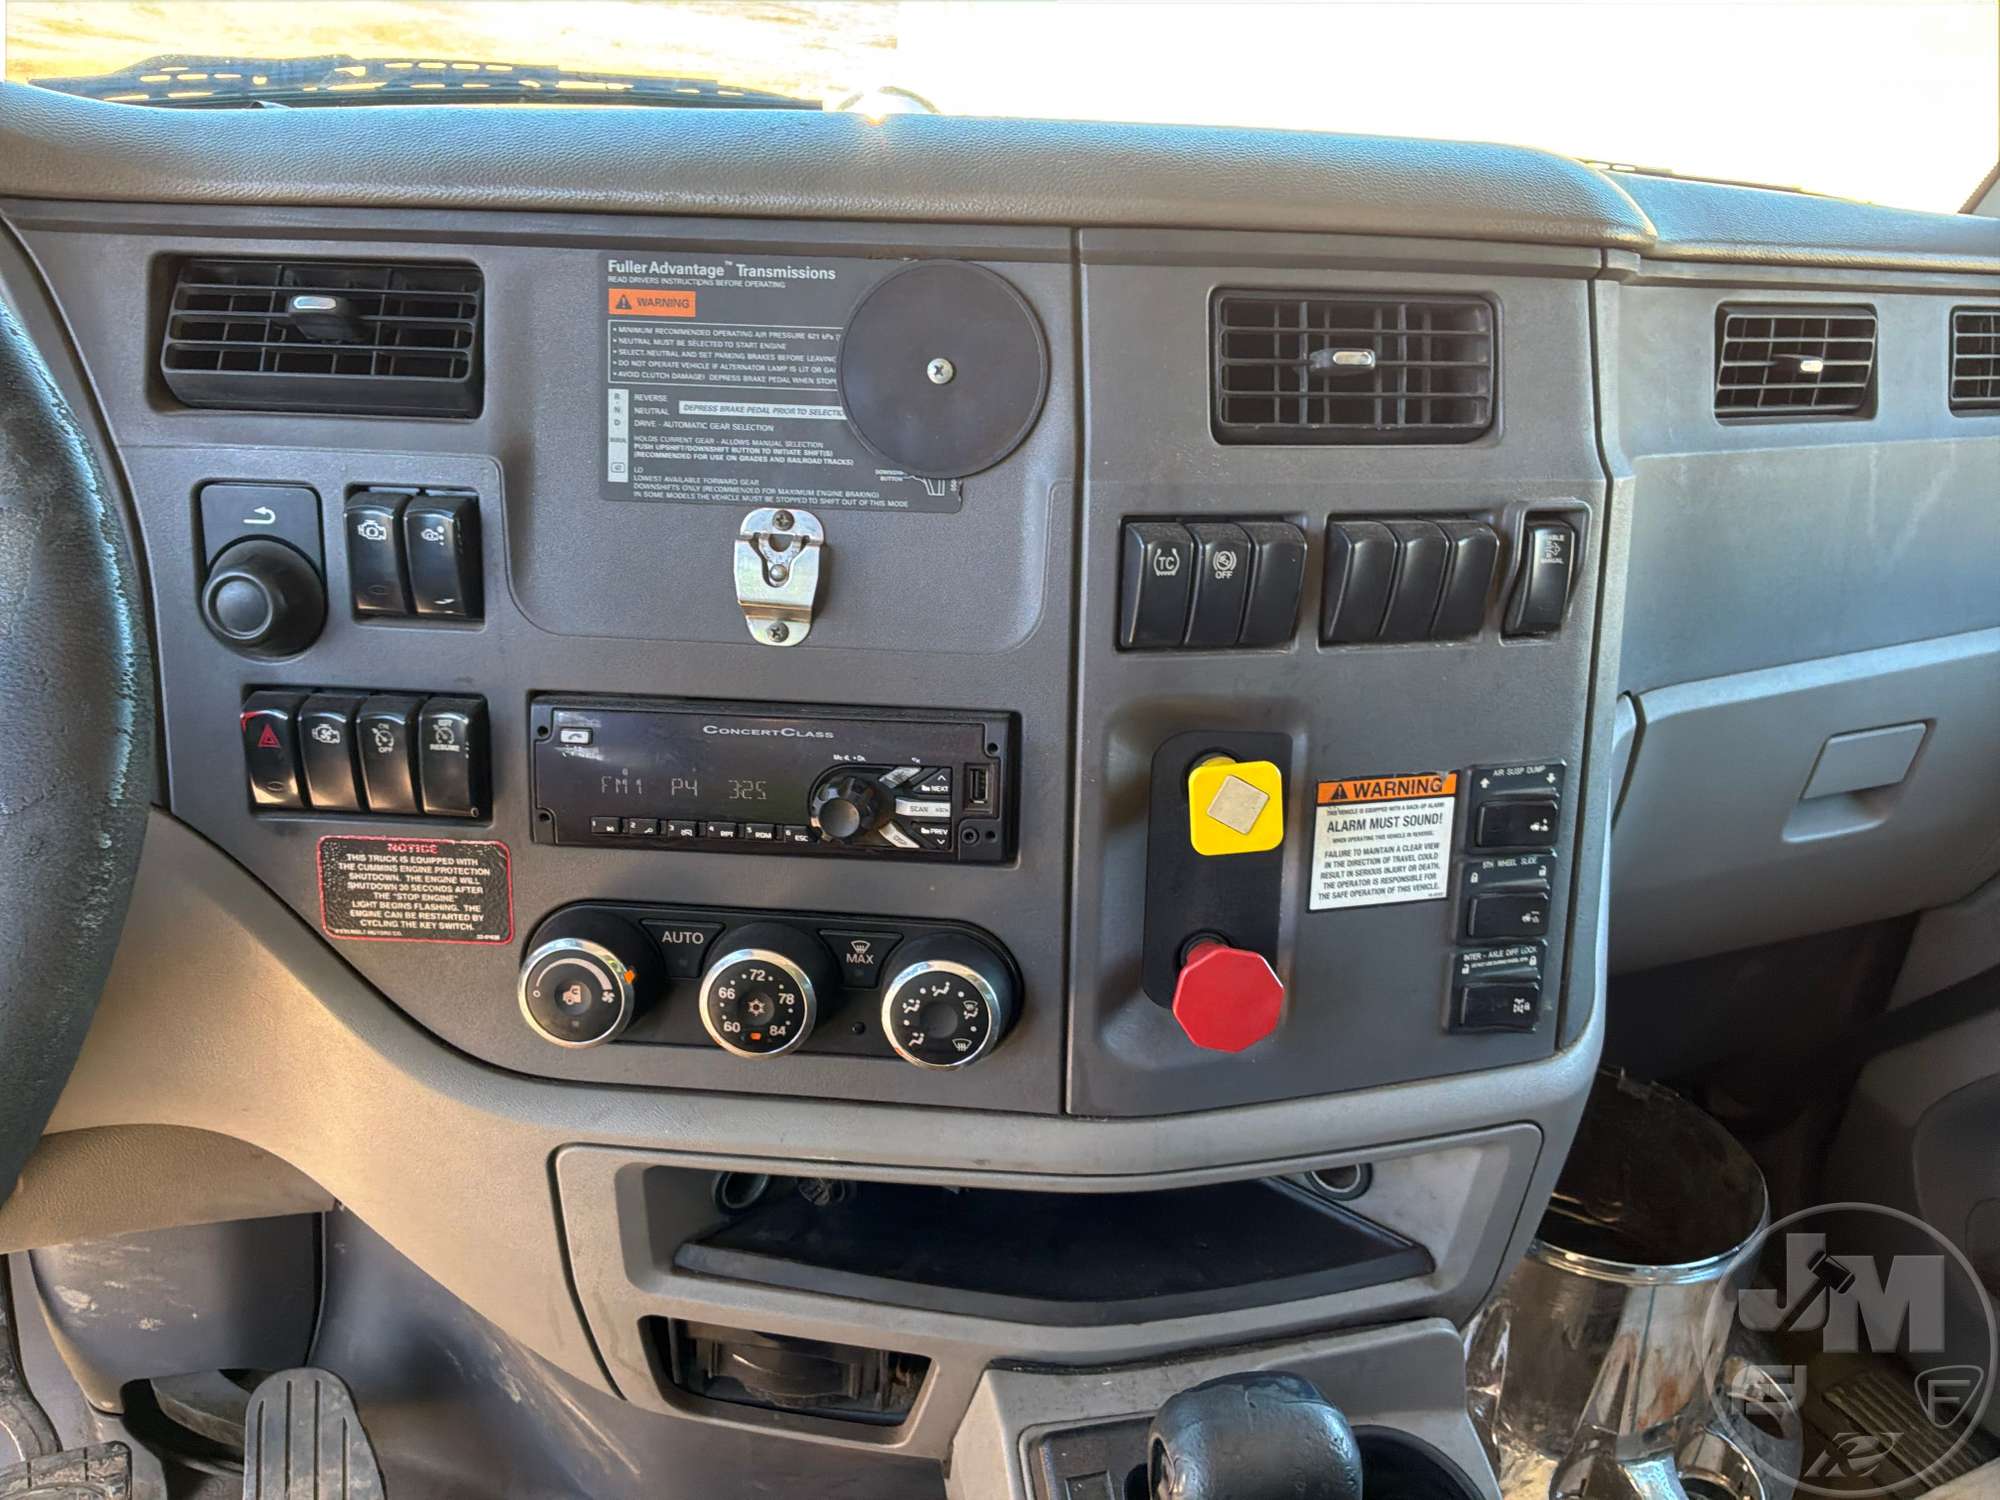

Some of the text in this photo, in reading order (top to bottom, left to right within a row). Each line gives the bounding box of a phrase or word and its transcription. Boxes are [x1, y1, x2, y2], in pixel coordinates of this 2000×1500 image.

[608, 260, 648, 273] Fuller
[736, 264, 836, 280] Transmissions
[608, 276, 786, 289] READ DRIVERS INSTRUCTIONS BEFORE OPERATING
[637, 297, 690, 309] WARNING
[619, 326, 653, 335] MINIMUM
[655, 327, 711, 337] RECOMMENDED
[713, 329, 754, 339] OPERATING
[769, 331, 805, 340] PRESSURE
[618, 338, 651, 346] NEUTRAL
[688, 340, 724, 349] SELECTED
[725, 341, 734, 349] TO
[736, 341, 758, 349] START
[760, 342, 786, 351] ENGINE
[634, 393, 668, 402] REVERSE
[634, 407, 670, 416] NEUTRAL
[683, 403, 718, 412] DEPRESS
[719, 404, 745, 413] BRAKE
[747, 406, 770, 415] PEDAL
[772, 407, 796, 416] PRIOR
[797, 408, 808, 416] TO
[634, 419, 774, 433] DRIVE AUTOMATIC GEAR SELECTION
[1158, 556, 1175, 571] TC
[1215, 570, 1233, 580] OFF
[1492, 765, 1546, 777] AIR SUSP DUMP
[671, 777, 698, 798] P4
[728, 779, 767, 800] 325
[930, 784, 950, 793] NEXT
[1353, 777, 1443, 798] WARNING
[909, 805, 929, 813] SCAN
[1327, 813, 1443, 833] ALARM MUST SOUND!
[754, 831, 773, 840] RDM
[794, 834, 809, 842] ESC
[929, 827, 949, 836] PREV
[387, 842, 439, 854] NOTICE
[1324, 842, 1440, 859] FAILURE TO MAINTAIN A CLEAR VIEW
[346, 853, 479, 866] THIS TRUCK IS EQUIPPED WITH
[1324, 853, 1439, 869] IN THE DIRECTION OF TRAVEL COULD
[338, 862, 491, 876] THE CUMMINS ENGINE PROTECTION
[1320, 870, 1345, 880] RESULT
[1346, 869, 1354, 878] IN
[1355, 867, 1382, 878] SERIOUS
[1383, 865, 1407, 876] INJURY
[1408, 864, 1417, 873] OR
[405, 874, 423, 883] THE
[424, 875, 457, 885] ENGINE
[459, 877, 481, 886] WILL
[1323, 872, 1437, 890] THE OPERATOR IS RESPONSIBLE FOR
[347, 882, 398, 892] SHUTDOWN
[410, 884, 453, 894] SECONDS
[455, 886, 484, 895] AFTER
[1318, 892, 1330, 901] THE
[1332, 890, 1348, 900] SAFE
[1350, 887, 1385, 898] OPERATION
[1386, 886, 1396, 895] OF
[1397, 884, 1411, 894] THIS
[373, 891, 391, 900] THE
[351, 900, 378, 909] LIGHT
[379, 901, 412, 911] BEGINS
[463, 904, 481, 913] THE
[349, 909, 485, 923] ENGINE CAN BE RESTARTED BY
[359, 919, 399, 929] CYCLING
[400, 920, 418, 929] THE
[419, 921, 437, 930] KEY
[661, 930, 705, 945] AUTO
[845, 953, 876, 966] MAX
[1463, 952, 1482, 962] INTER
[1487, 949, 1504, 959] AXLE
[1505, 947, 1520, 956] DIFF
[1520, 945, 1538, 955] LOCK
[749, 969, 767, 982] 72
[718, 987, 736, 1000] 66
[778, 993, 795, 1006] 78
[723, 1021, 741, 1033] 60
[769, 1025, 787, 1037] 84
